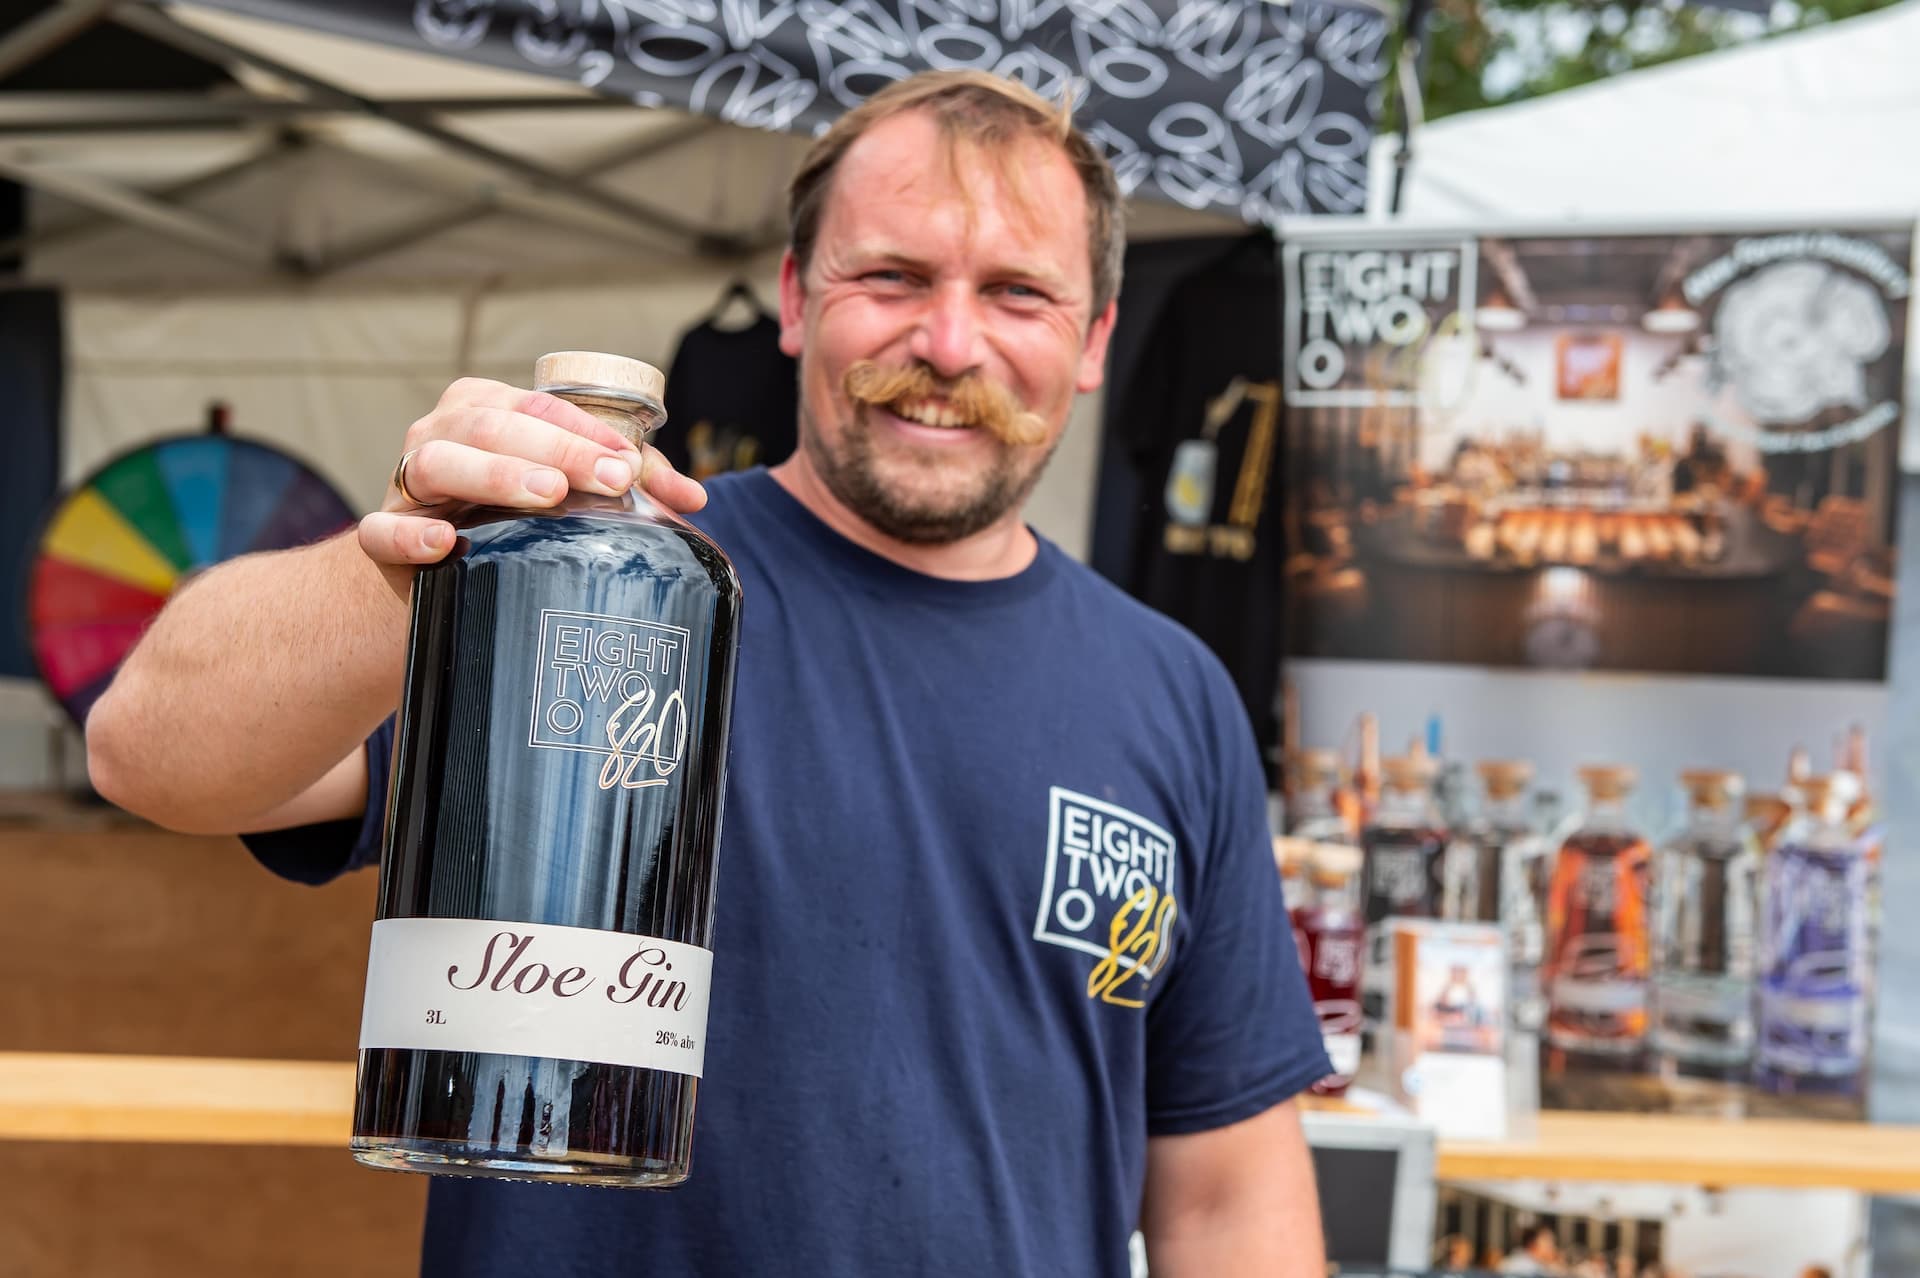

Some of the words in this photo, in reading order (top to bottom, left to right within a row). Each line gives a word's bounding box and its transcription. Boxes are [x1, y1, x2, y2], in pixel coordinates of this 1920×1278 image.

[1303, 252, 1457, 302] EIGHT
[1304, 294, 1427, 346] TWO
[554, 624, 678, 675] EIGHT
[551, 660, 651, 707] TWO
[546, 699, 584, 735] O
[1063, 805, 1168, 883] EIGHT
[1062, 845, 1154, 912] TWO
[1055, 888, 1096, 932] O
[447, 931, 597, 998] Sloe
[606, 940, 693, 1012] Gin
[425, 1009, 447, 1026] 3L
[655, 1030, 679, 1048] 26%
[680, 1034, 696, 1050] abv
